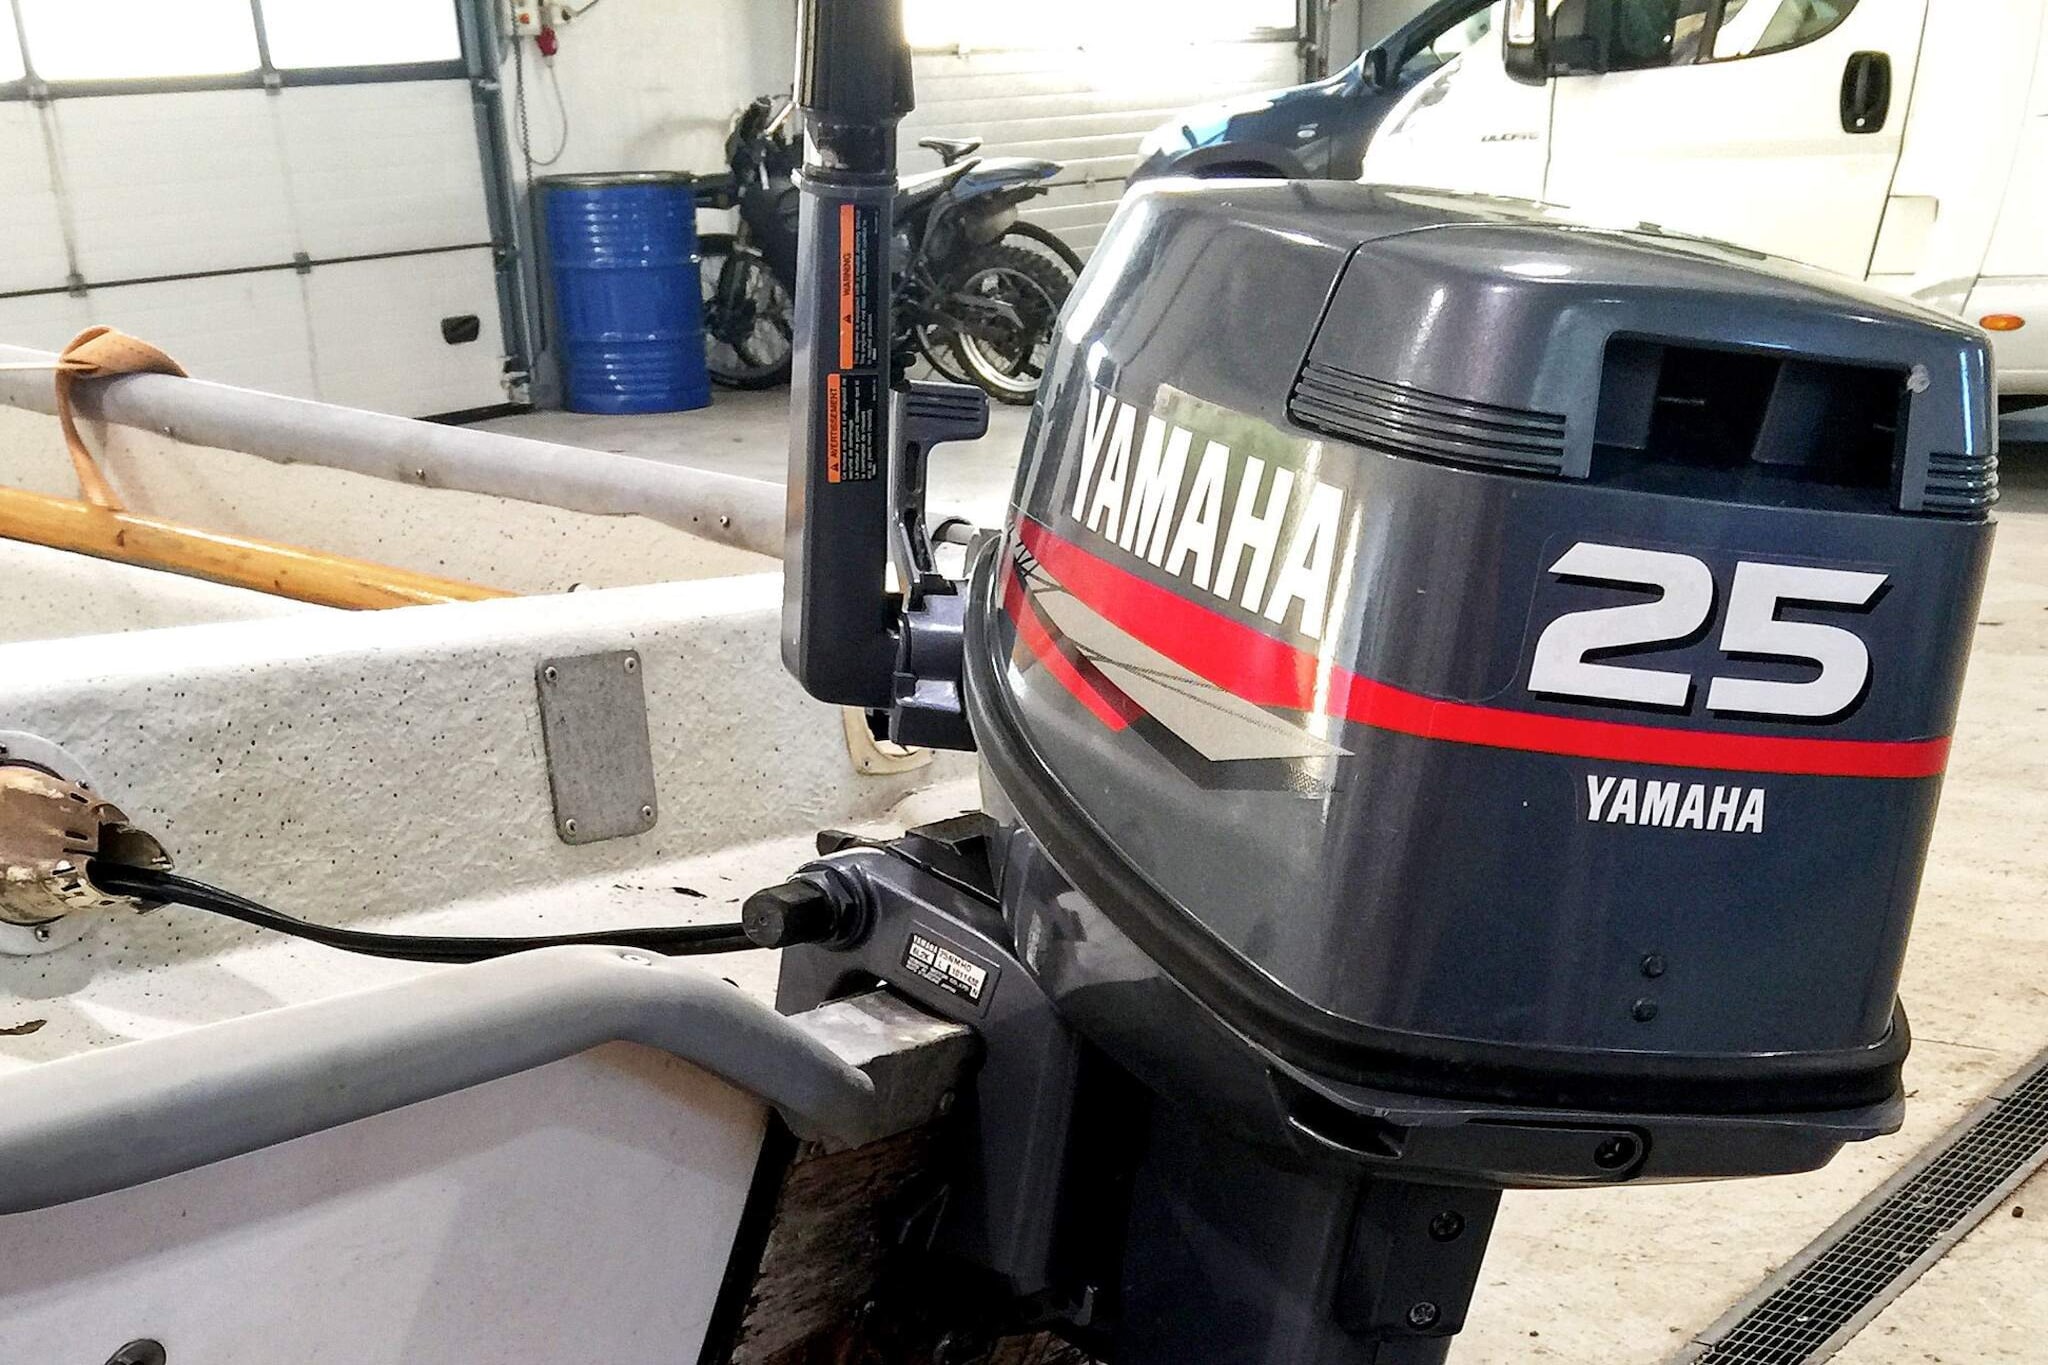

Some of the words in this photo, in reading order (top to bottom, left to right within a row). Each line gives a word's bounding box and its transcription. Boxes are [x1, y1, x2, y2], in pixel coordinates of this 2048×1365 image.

[842, 252, 852, 296] WARNING
[830, 388, 838, 458] AVERTISSEMENT
[1071, 386, 1344, 640] YAMAHA
[1528, 541, 1889, 722] 25
[1587, 775, 1765, 833] YAMAHA
